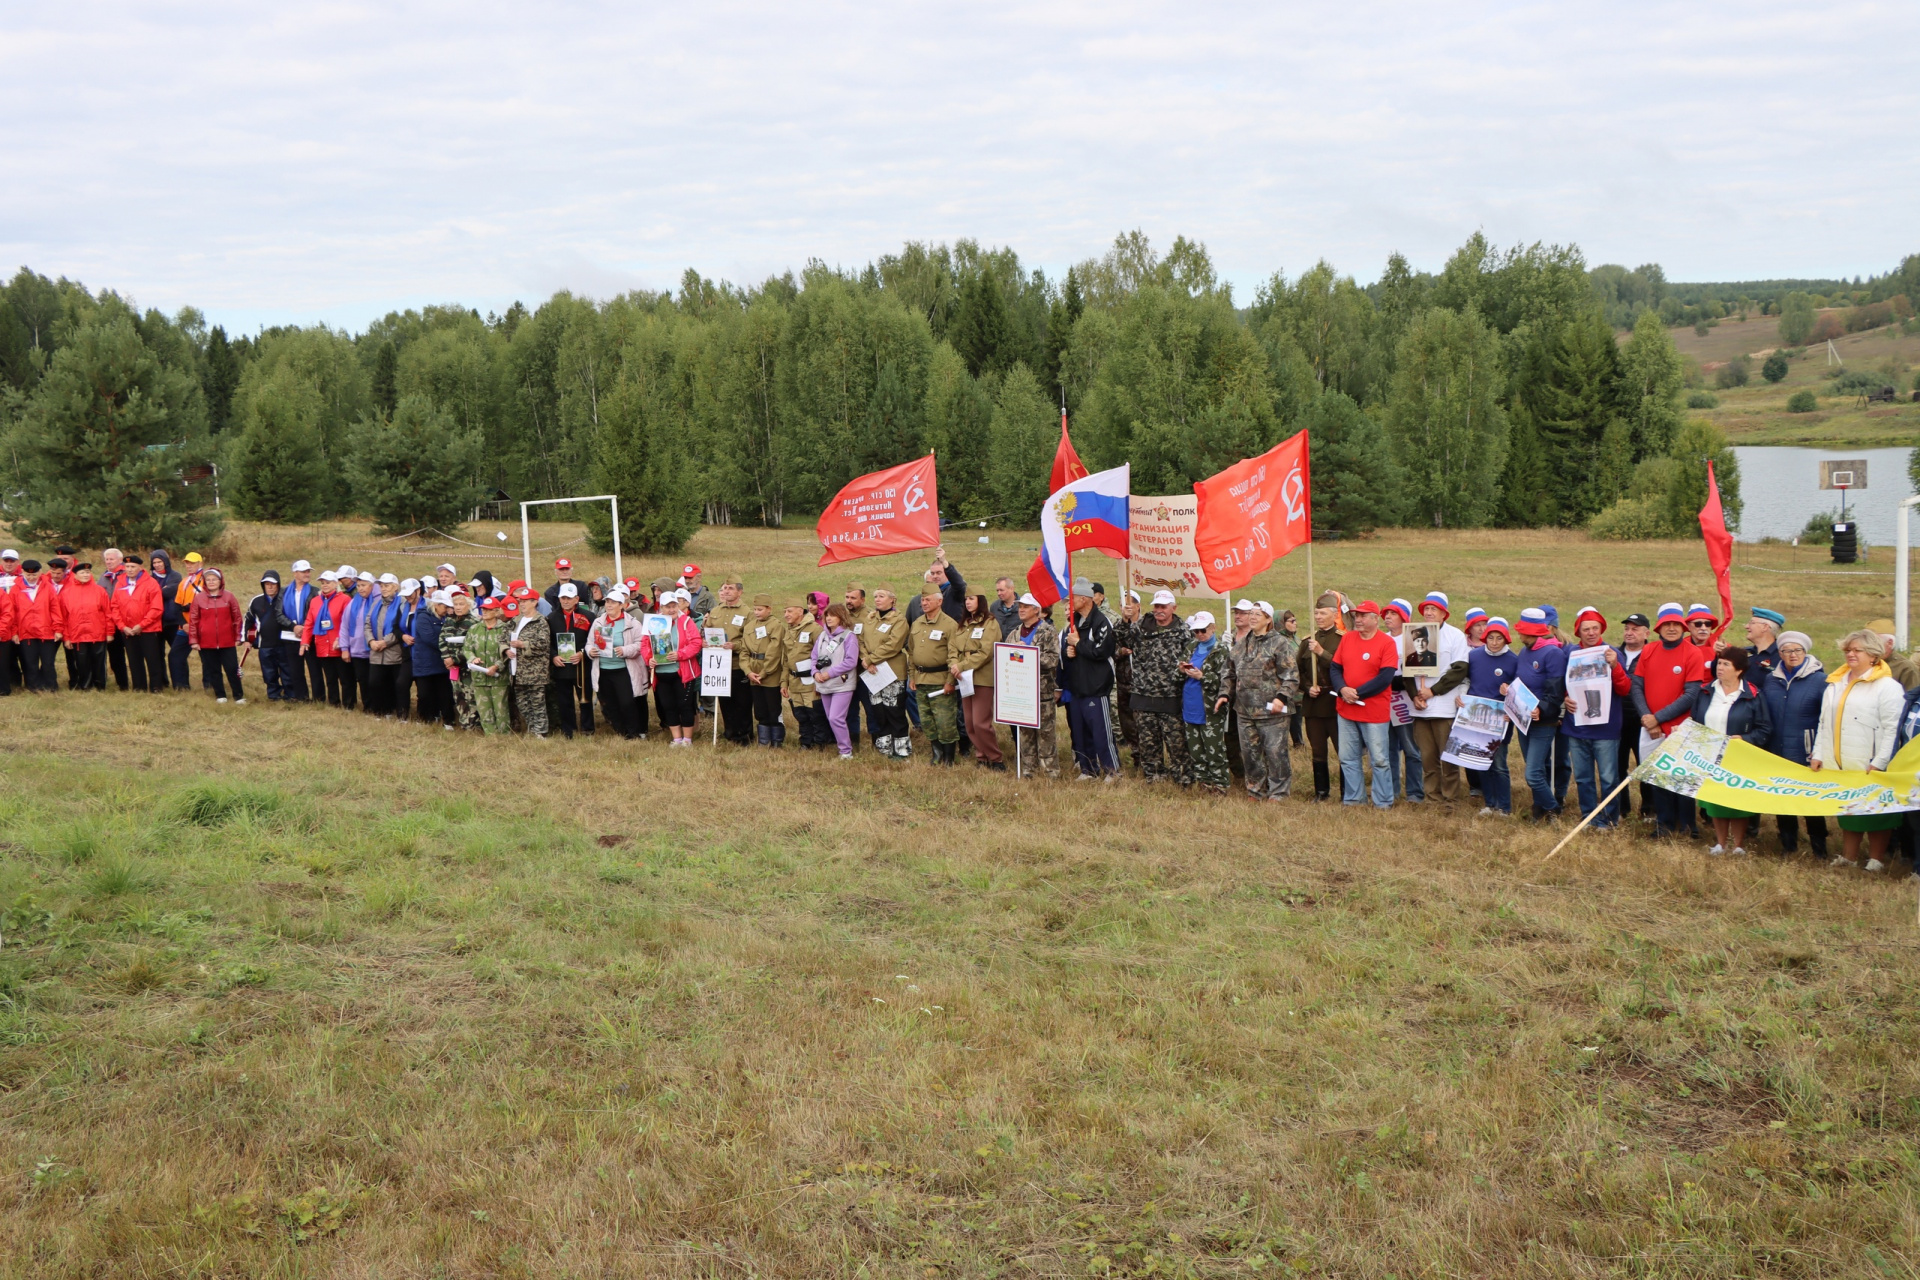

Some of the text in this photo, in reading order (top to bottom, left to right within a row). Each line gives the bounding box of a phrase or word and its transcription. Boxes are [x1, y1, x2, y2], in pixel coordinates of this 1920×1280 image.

[1173, 508, 1196, 516] ПОЛК
[1133, 533, 1183, 545] ВЕТЕРАНОВ
[1138, 545, 1183, 556] ГУ МВД РФ
[1134, 553, 1178, 569] Пермскому
[709, 654, 722, 668] ГУ
[704, 674, 725, 687] ФСИН
